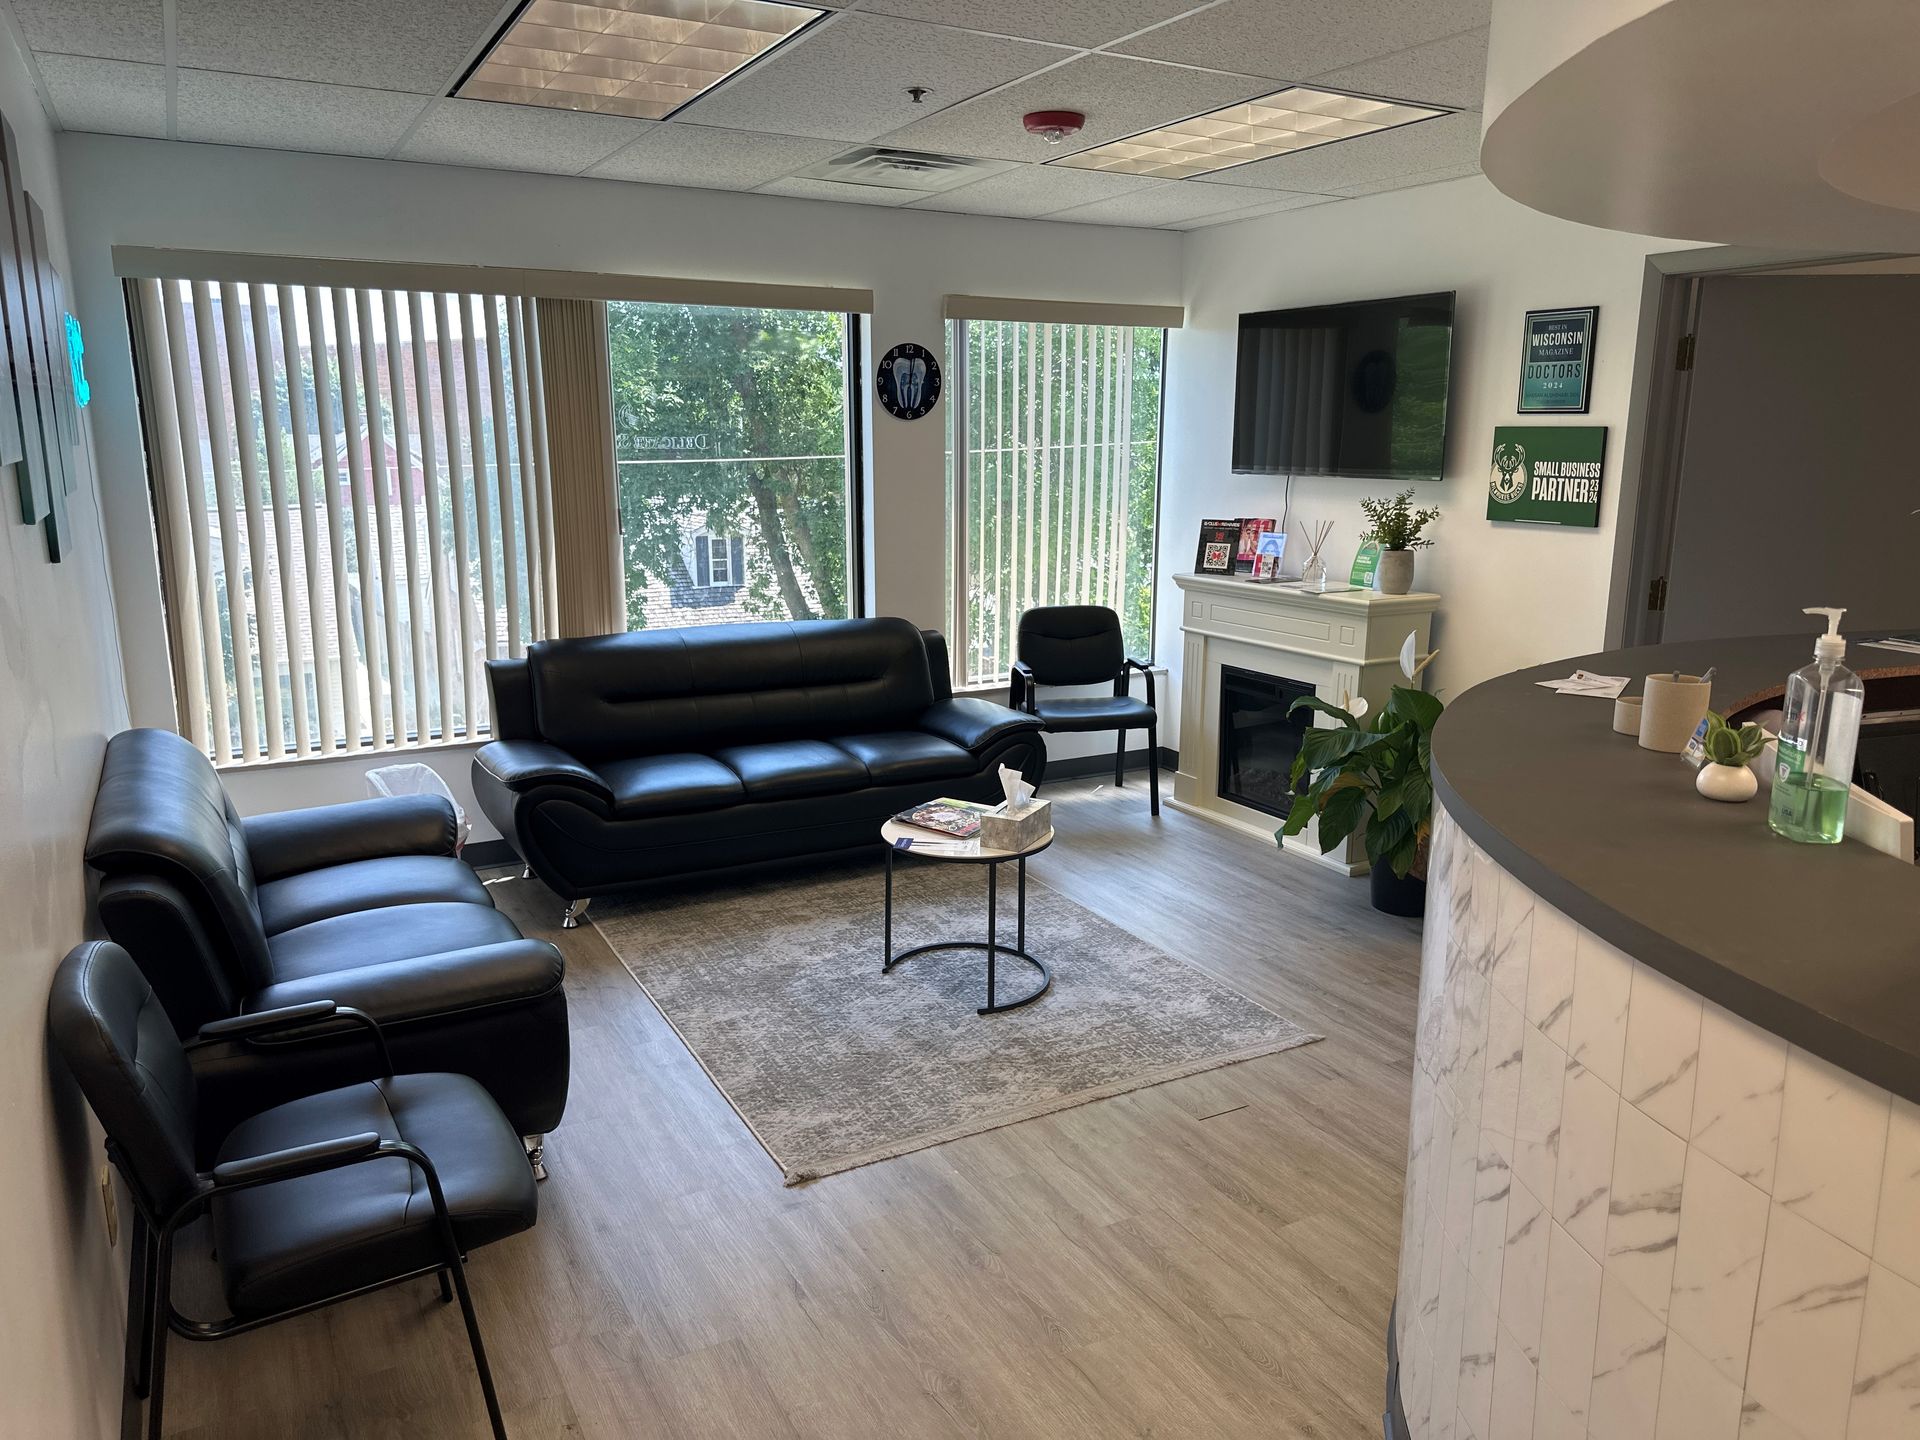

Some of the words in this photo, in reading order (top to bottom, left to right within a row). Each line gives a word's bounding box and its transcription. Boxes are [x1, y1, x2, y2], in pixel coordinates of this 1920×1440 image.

[1532, 331, 1584, 347] WISCONSIN
[893, 348, 898, 356] 11
[905, 344, 914, 353] 12
[922, 349, 925, 357] 1
[1538, 347, 1575, 357] MAGAZINE
[882, 360, 892, 369] 10
[931, 361, 937, 370] 2
[1527, 363, 1582, 379] DOCTORS
[878, 377, 884, 386] 9
[934, 377, 940, 387] 3
[1543, 381, 1564, 389] 2024
[882, 394, 888, 403] 8
[929, 394, 936, 403] 4
[892, 406, 898, 415] 7
[906, 411, 912, 419] 6
[920, 406, 926, 415] 5
[1533, 461, 1560, 477] SMALL
[1560, 462, 1601, 478] BUSINESS
[1531, 477, 1589, 503] PARTNER
[1589, 479, 1600, 492] 23
[1588, 491, 1598, 504] 24
